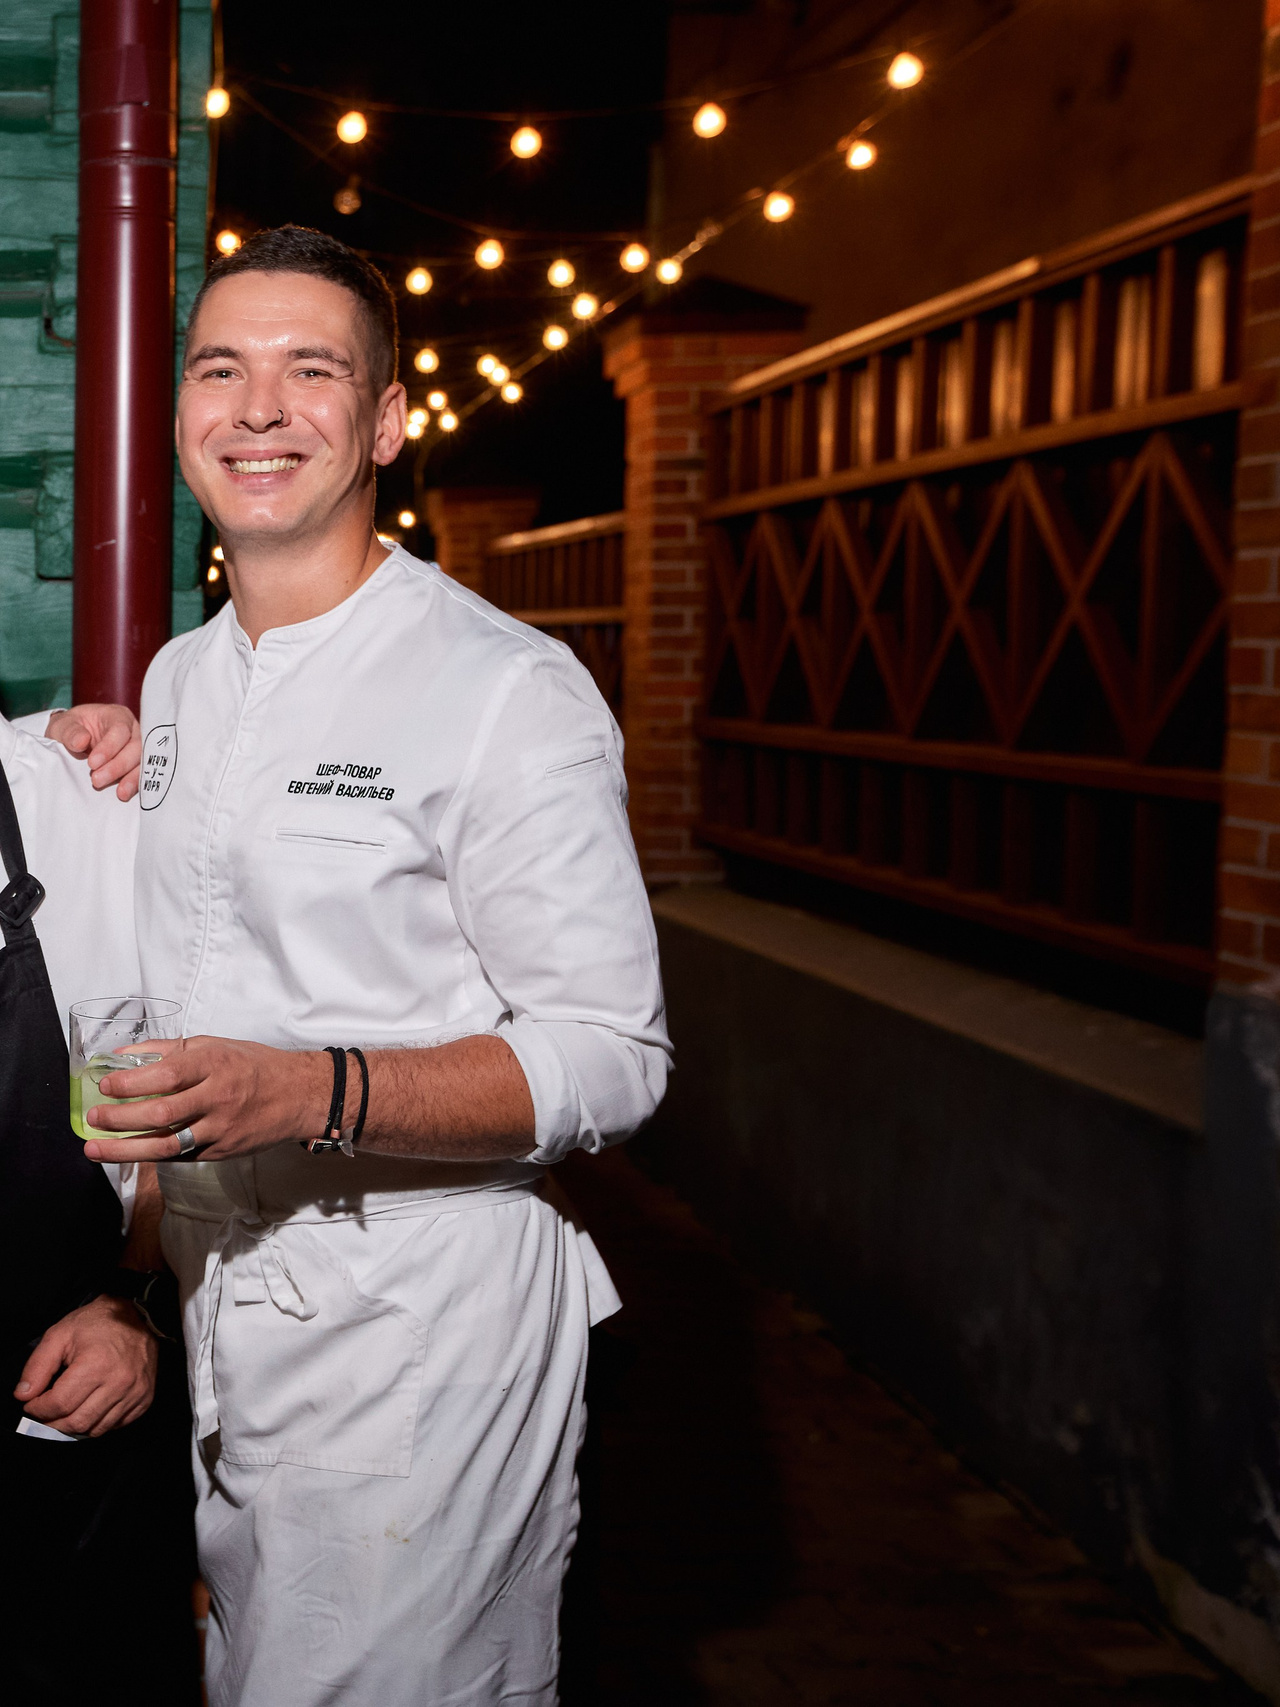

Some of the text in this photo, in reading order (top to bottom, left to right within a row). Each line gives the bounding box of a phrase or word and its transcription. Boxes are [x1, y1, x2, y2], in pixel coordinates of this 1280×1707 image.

[147, 754, 168, 768] МЕЧТЫ
[316, 763, 382, 780] ШЕФ-ПОВАР
[143, 780, 161, 792] МОРЯ
[287, 779, 396, 801] ЕВГЕНИЙ ВАСИЛЬЕВ
